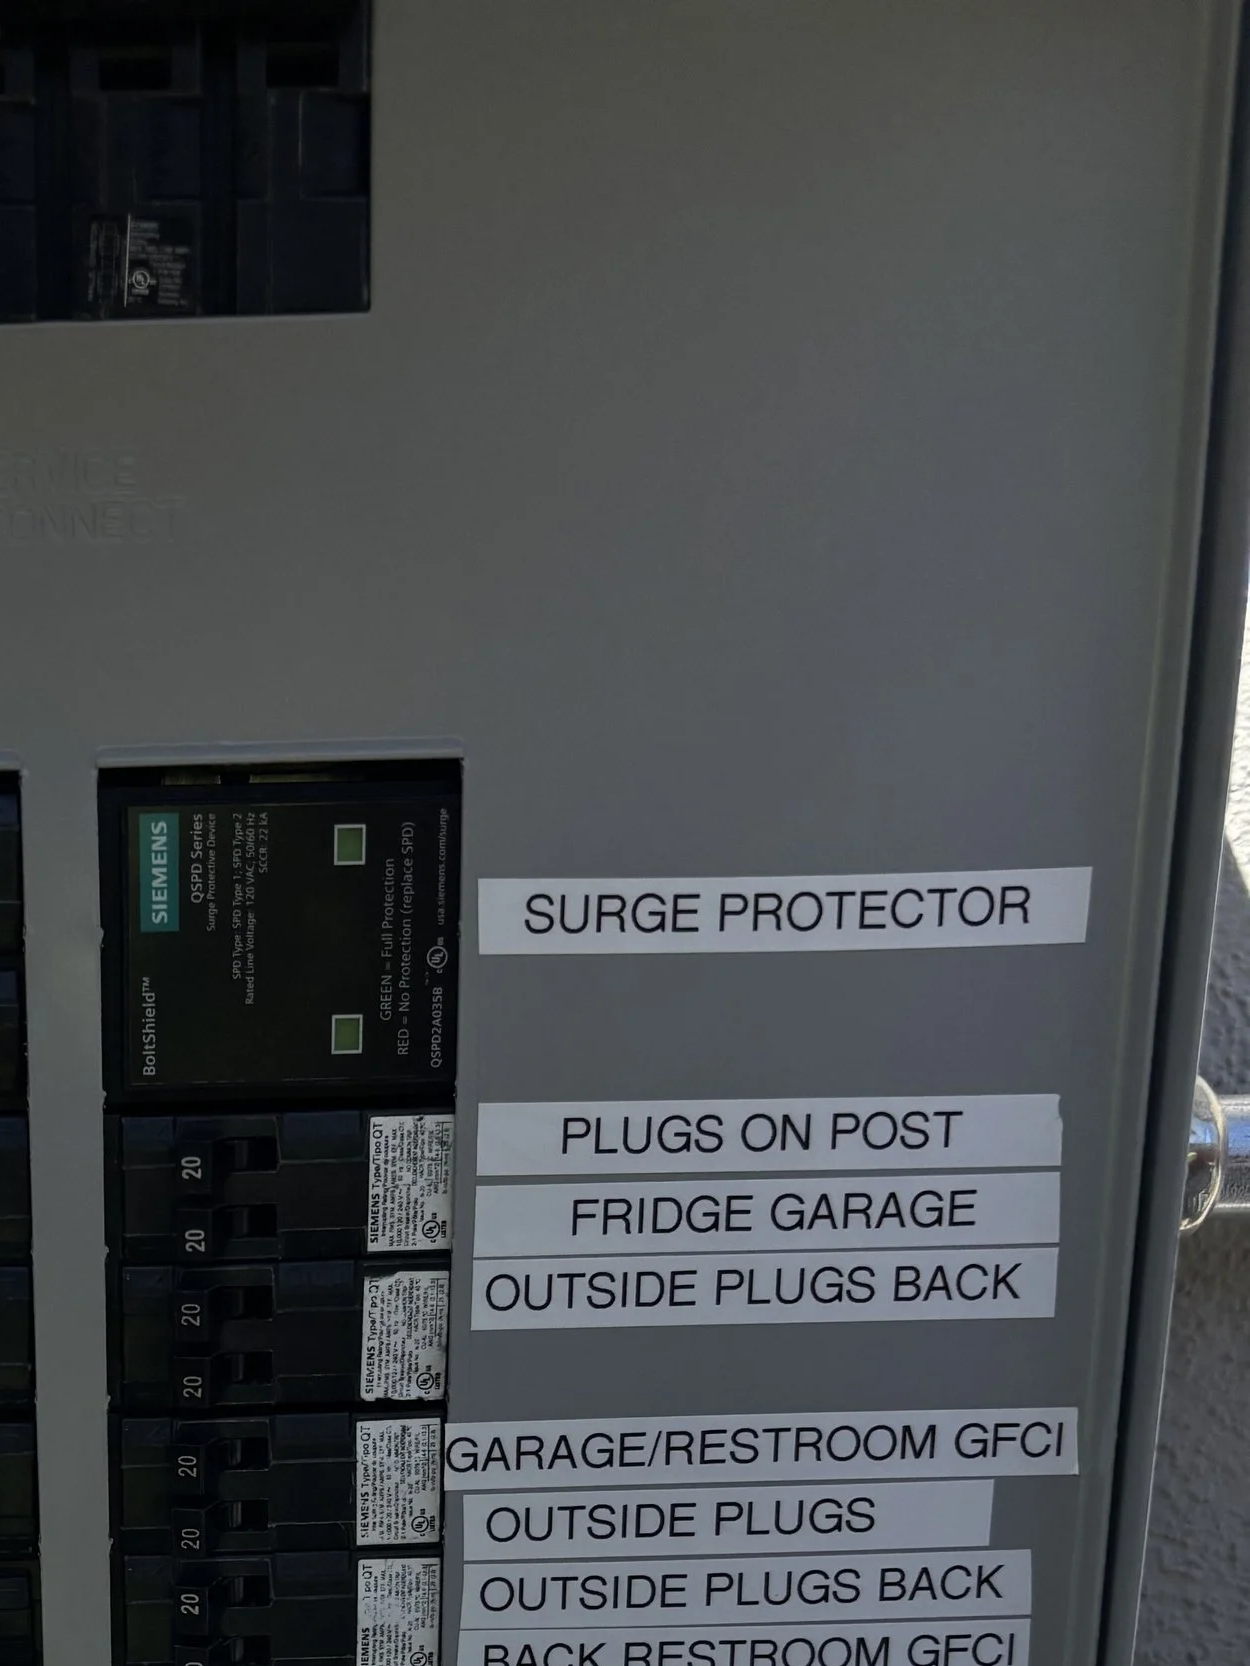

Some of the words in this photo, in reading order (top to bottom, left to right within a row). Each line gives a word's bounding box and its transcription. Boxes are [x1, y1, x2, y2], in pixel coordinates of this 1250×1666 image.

[190, 814, 203, 859] Series
[206, 814, 216, 847] Device
[258, 828, 268, 841] 22
[401, 822, 416, 854] SPD)
[151, 821, 169, 923] SIEMENS
[190, 863, 205, 903] QSPD
[206, 850, 216, 899] Protective
[400, 859, 414, 914] (replace
[382, 859, 394, 928] Protection
[525, 893, 700, 934] SURGE
[719, 886, 1030, 932] PROTECTOR
[206, 903, 217, 931] Surge
[381, 933, 393, 957] Full
[399, 919, 411, 988] Protection
[380, 975, 393, 1021] GREEN
[399, 992, 410, 1012] No
[397, 1029, 409, 1055] RED
[430, 987, 443, 1068] QSPD2A035B
[562, 1114, 723, 1154] PLUGS
[741, 1114, 811, 1152] ON
[831, 1111, 963, 1150] POST
[181, 1157, 201, 1179] 20
[572, 1195, 753, 1236] FRIDGE
[771, 1189, 977, 1231] GARAGE
[185, 1230, 205, 1252] 20
[486, 1270, 697, 1311] OUTSIDE
[716, 1266, 875, 1305] PLUGS
[894, 1263, 1022, 1301] BACK
[181, 1304, 200, 1326] 20
[183, 1376, 202, 1398] 20
[178, 1456, 197, 1477] 20
[446, 1424, 937, 1473] GARAGE/RESTROOM
[955, 1422, 1063, 1459] GFCI
[181, 1529, 199, 1549] 20
[486, 1503, 696, 1542] OUTSIDE
[715, 1497, 875, 1536] PLUGS
[181, 1594, 199, 1615] 20
[480, 1574, 687, 1611] OUTSIDE
[706, 1568, 860, 1606] PLUGS
[879, 1565, 1004, 1601] BACK
